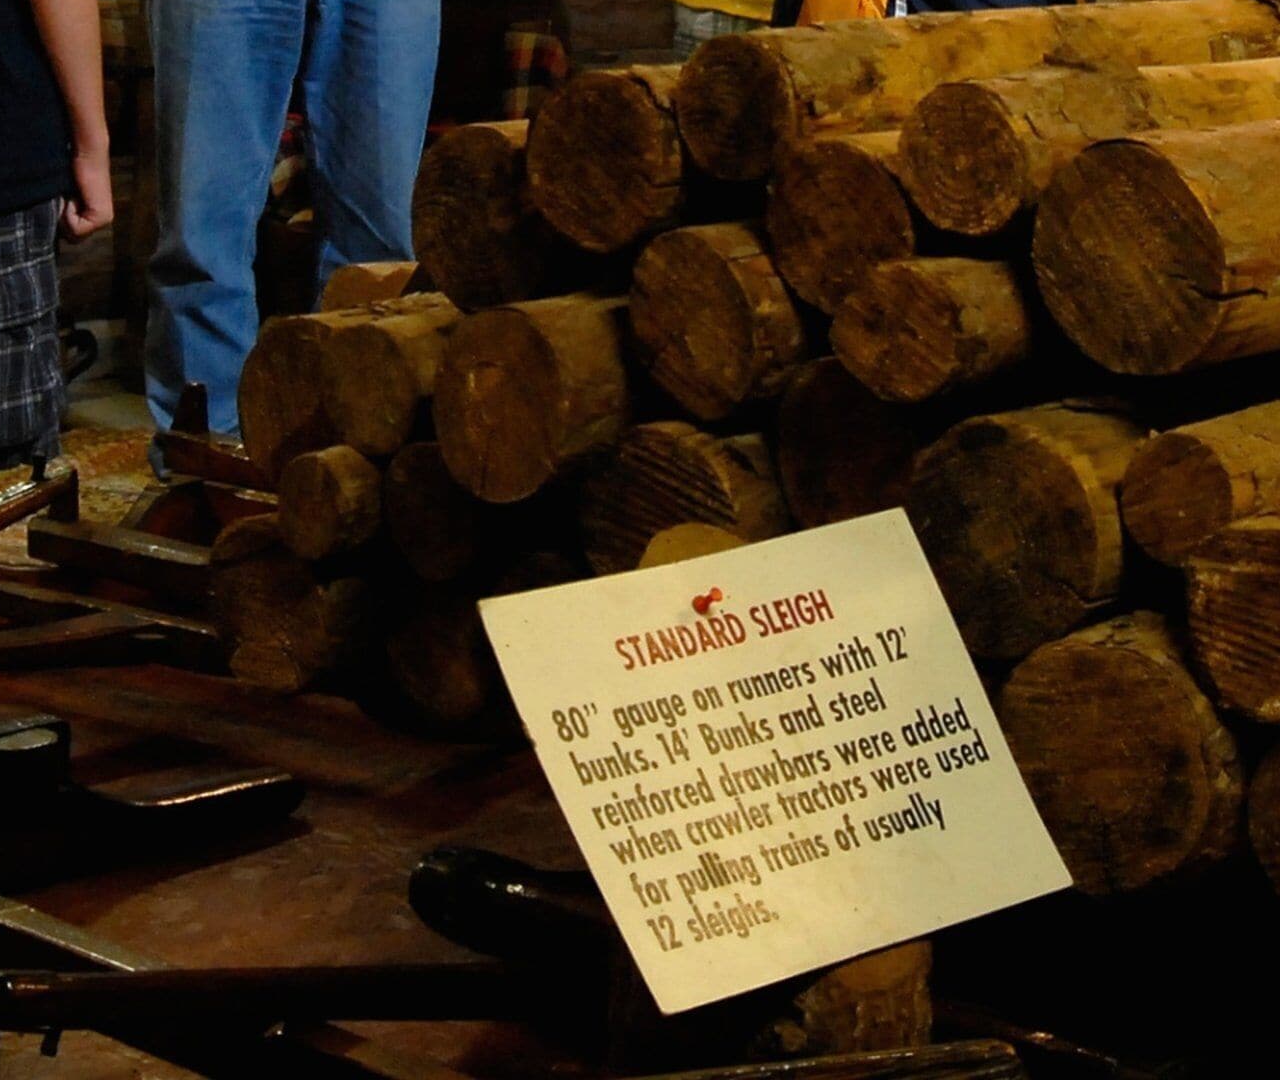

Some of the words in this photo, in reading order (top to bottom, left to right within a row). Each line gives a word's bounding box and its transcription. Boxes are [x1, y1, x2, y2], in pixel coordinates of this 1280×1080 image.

[612, 693, 687, 738] gauge
[692, 684, 724, 711] on
[726, 661, 817, 704] runners
[819, 635, 877, 679] with
[875, 626, 909, 663] 12'
[615, 612, 747, 671] STANDARD
[748, 588, 835, 638] SLEIGH
[569, 741, 659, 786] bunks.
[655, 728, 690, 765] 14'
[697, 711, 775, 756] Bunks
[778, 693, 825, 736] and
[828, 676, 887, 722] steel
[591, 767, 716, 830] reinforced
[719, 748, 832, 797] drawbars
[833, 729, 897, 766] were
[901, 696, 972, 748] added
[609, 825, 683, 865] when
[685, 796, 773, 846] crawler
[776, 773, 869, 821] tractors
[869, 756, 932, 793] were
[935, 727, 990, 773] used
[629, 871, 672, 908] for
[676, 851, 762, 905] pulling
[759, 831, 830, 873] trains
[836, 814, 862, 851] of
[866, 793, 947, 845] usually
[647, 914, 683, 952] 12
[686, 893, 780, 943] sleighs.
